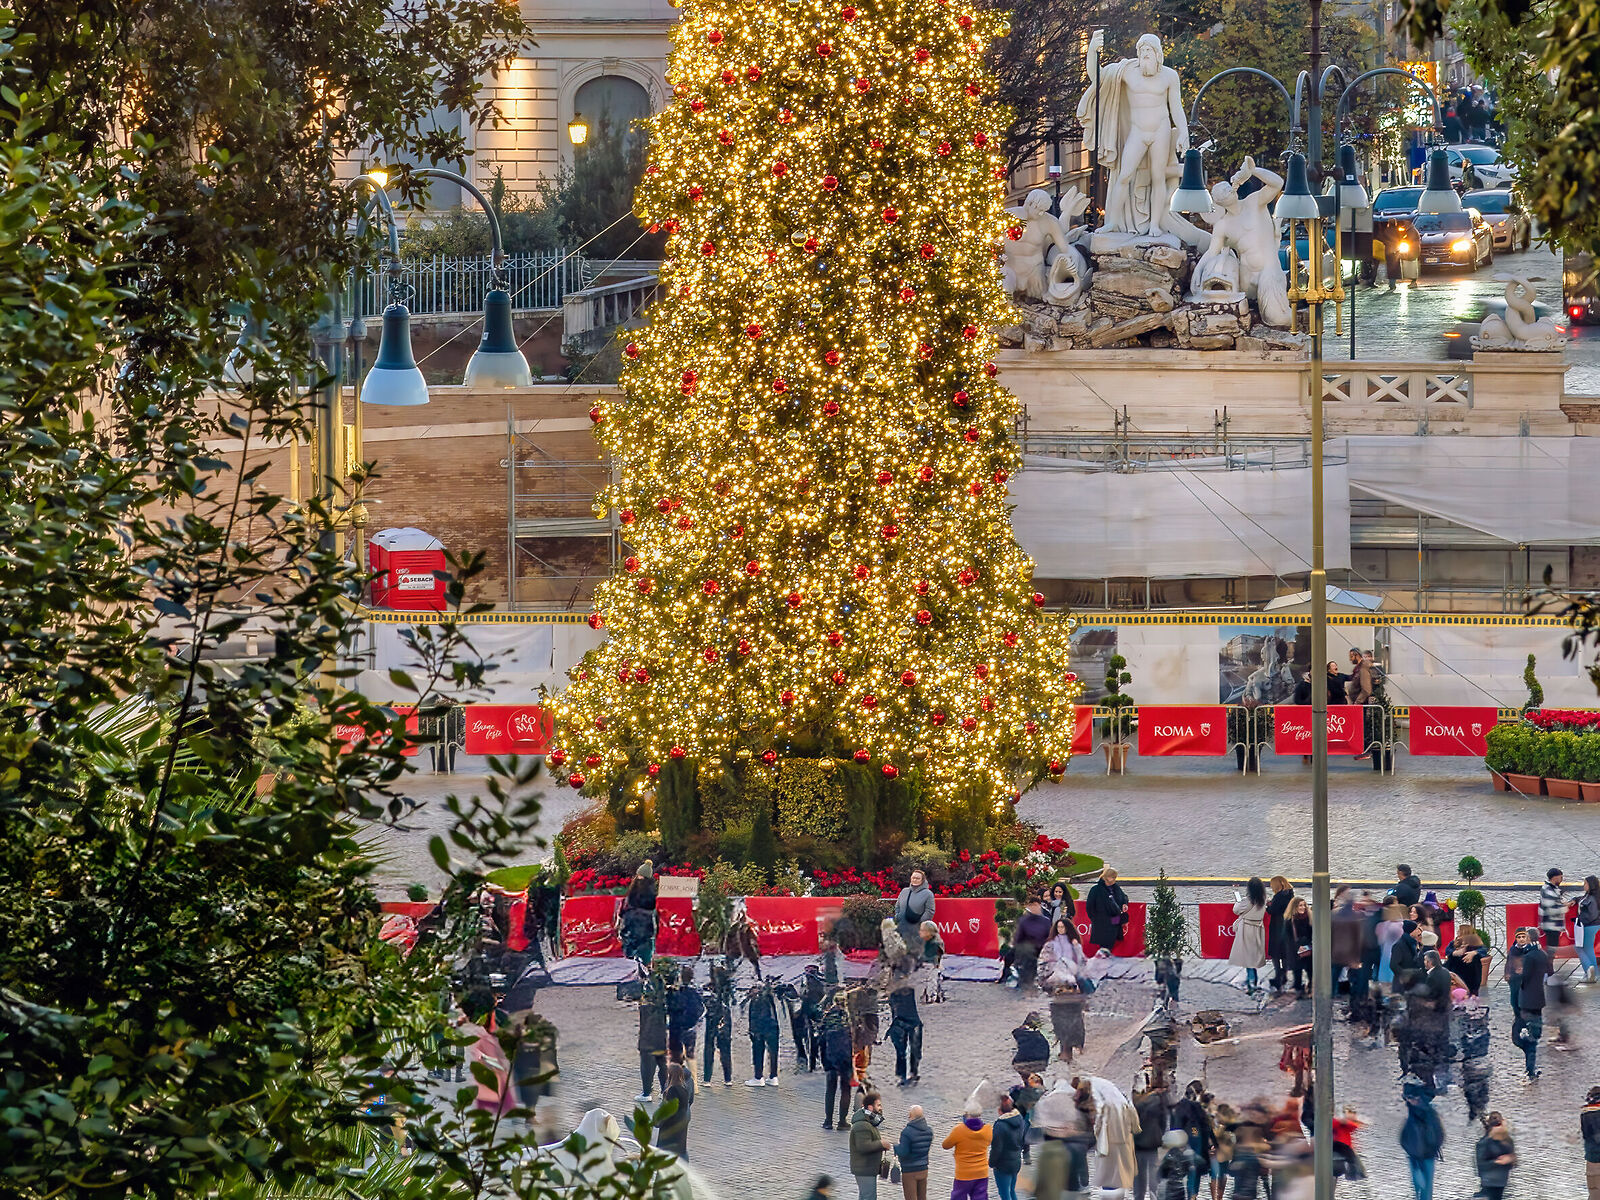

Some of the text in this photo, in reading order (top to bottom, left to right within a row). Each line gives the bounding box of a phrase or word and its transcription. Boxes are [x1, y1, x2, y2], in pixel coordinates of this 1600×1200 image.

[472, 720, 495, 733] Buone
[1154, 725, 1194, 737] ROMA
[1281, 721, 1304, 734] Buone
[1425, 725, 1465, 737] ROMA
[485, 728, 503, 740] feste
[938, 921, 962, 934] MA
[1218, 924, 1236, 937] RO
